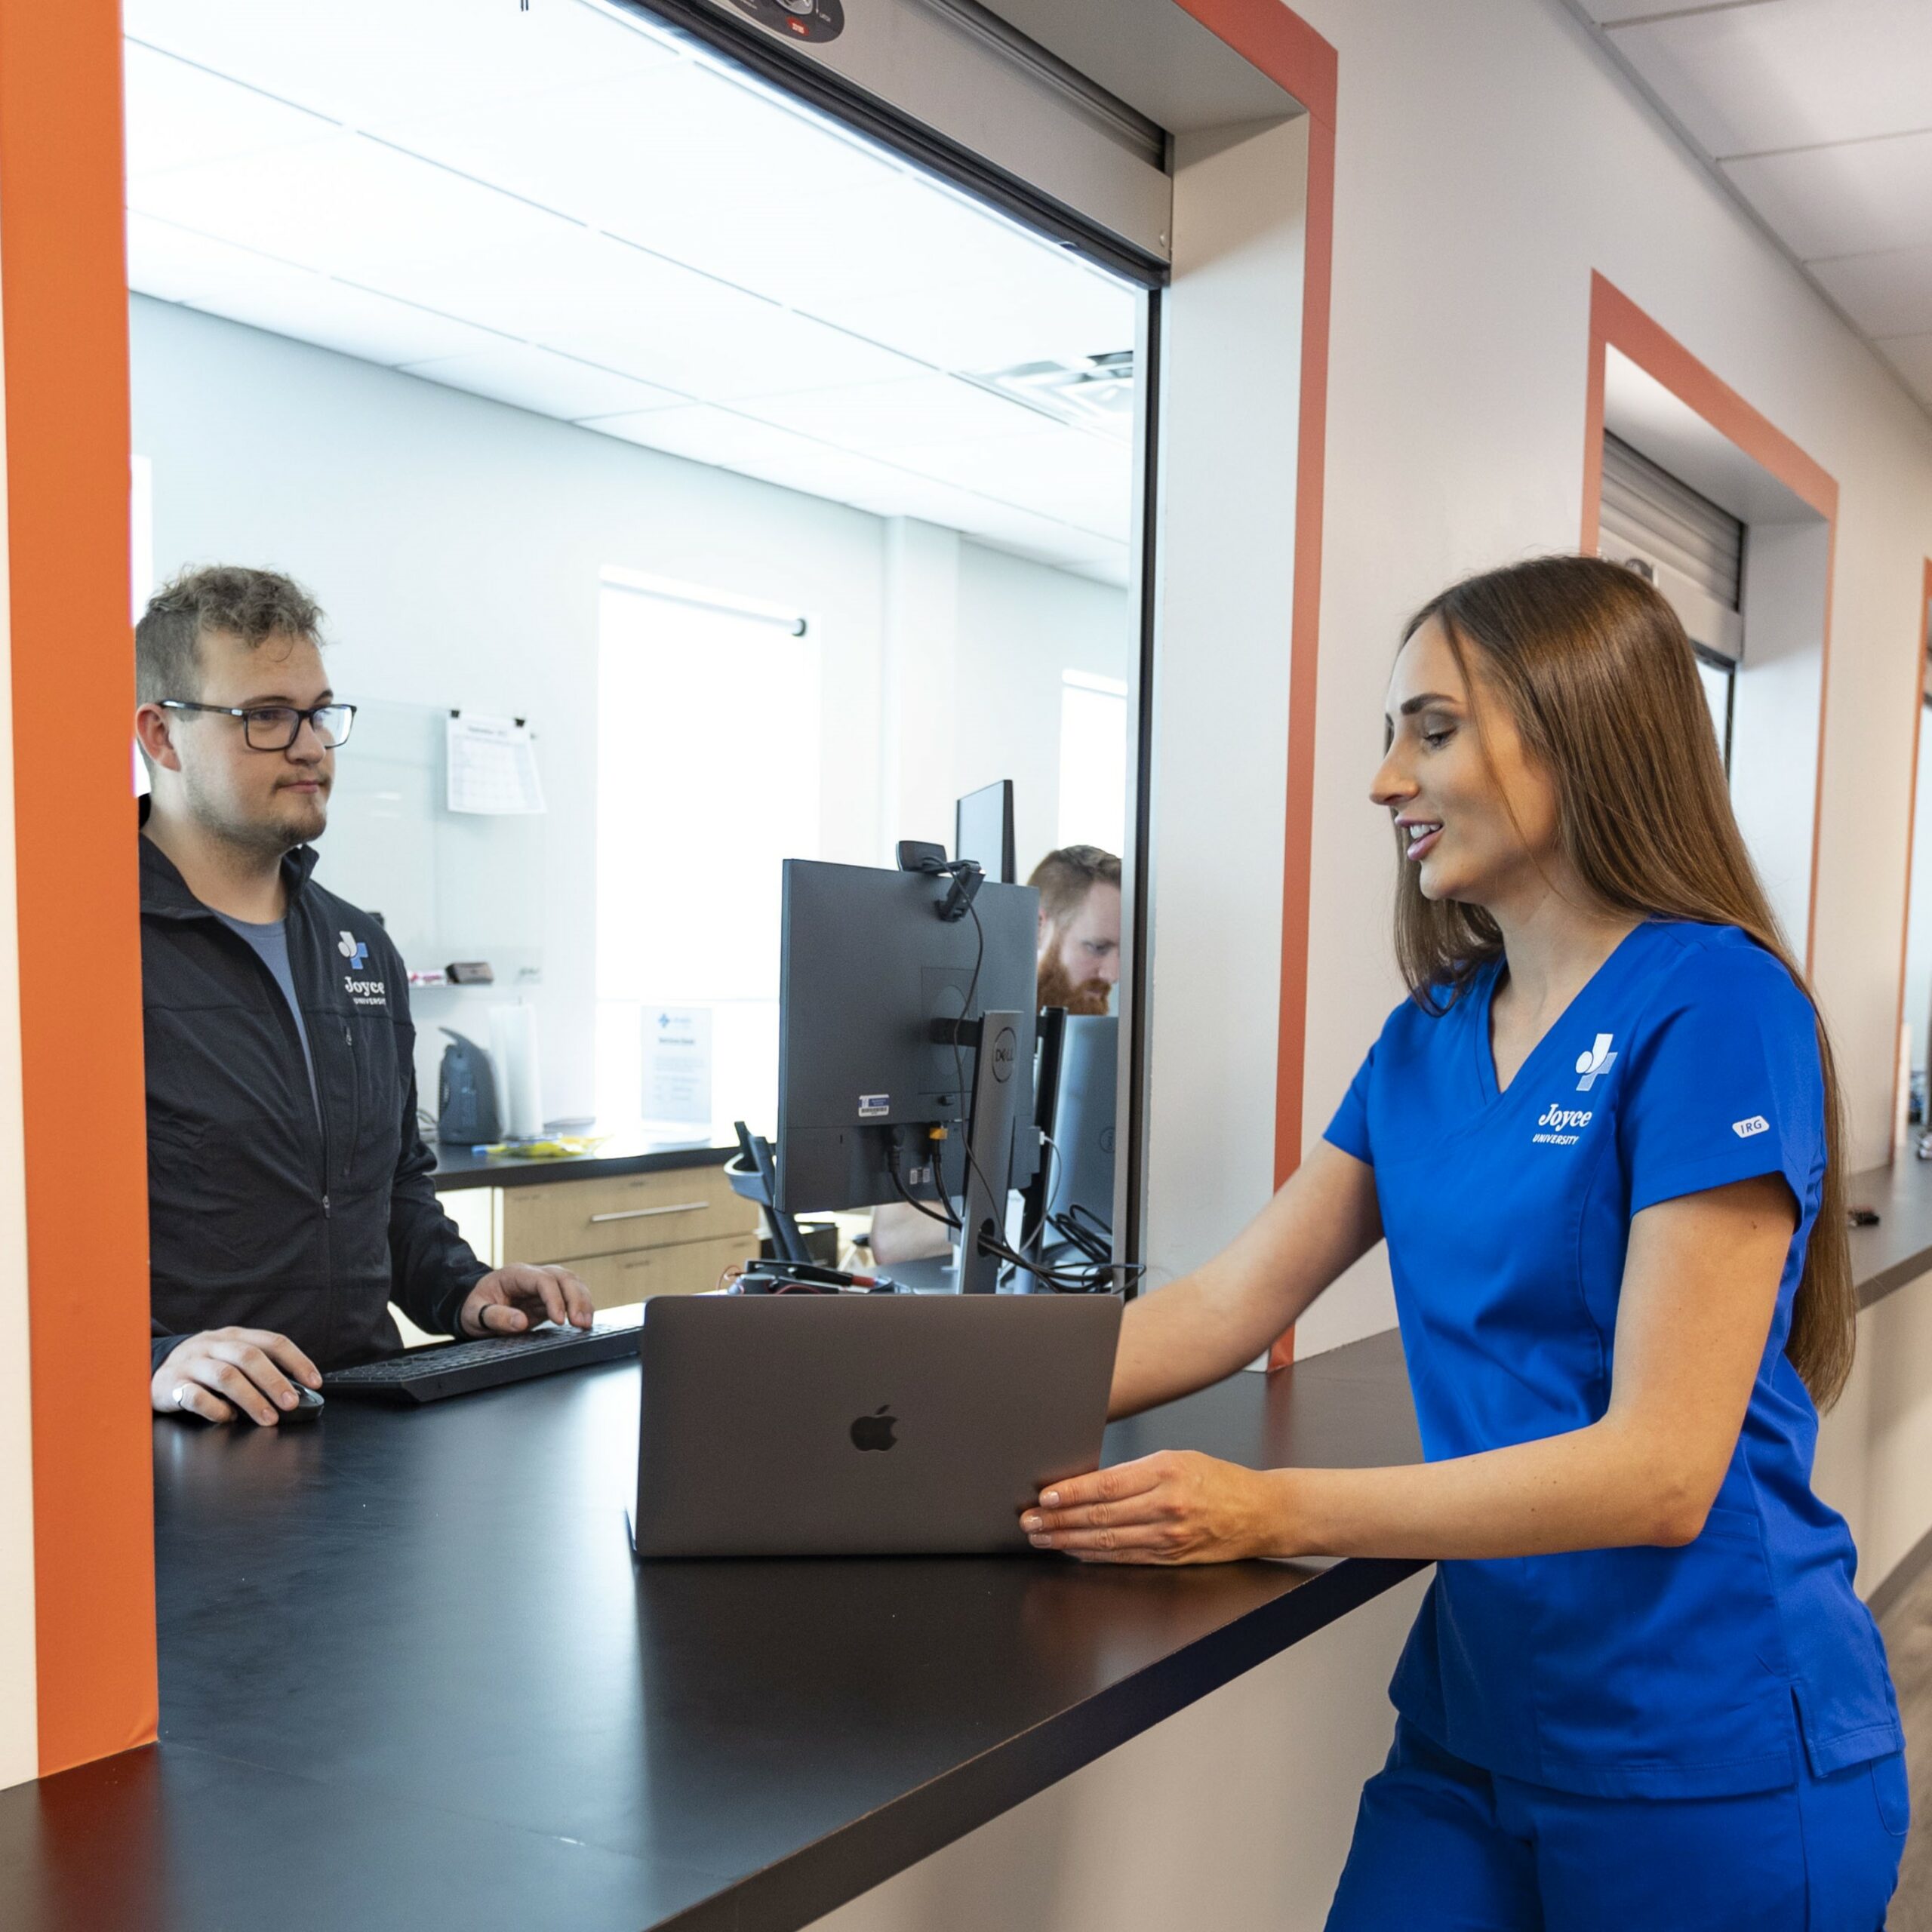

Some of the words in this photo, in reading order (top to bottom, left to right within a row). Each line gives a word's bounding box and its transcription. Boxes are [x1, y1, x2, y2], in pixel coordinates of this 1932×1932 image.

[344, 976, 385, 996] Joyce
[1538, 1103, 1592, 1132] Joyce
[1741, 1119, 1762, 1134] IRG
[1532, 1134, 1580, 1146] UNIVERSITY
